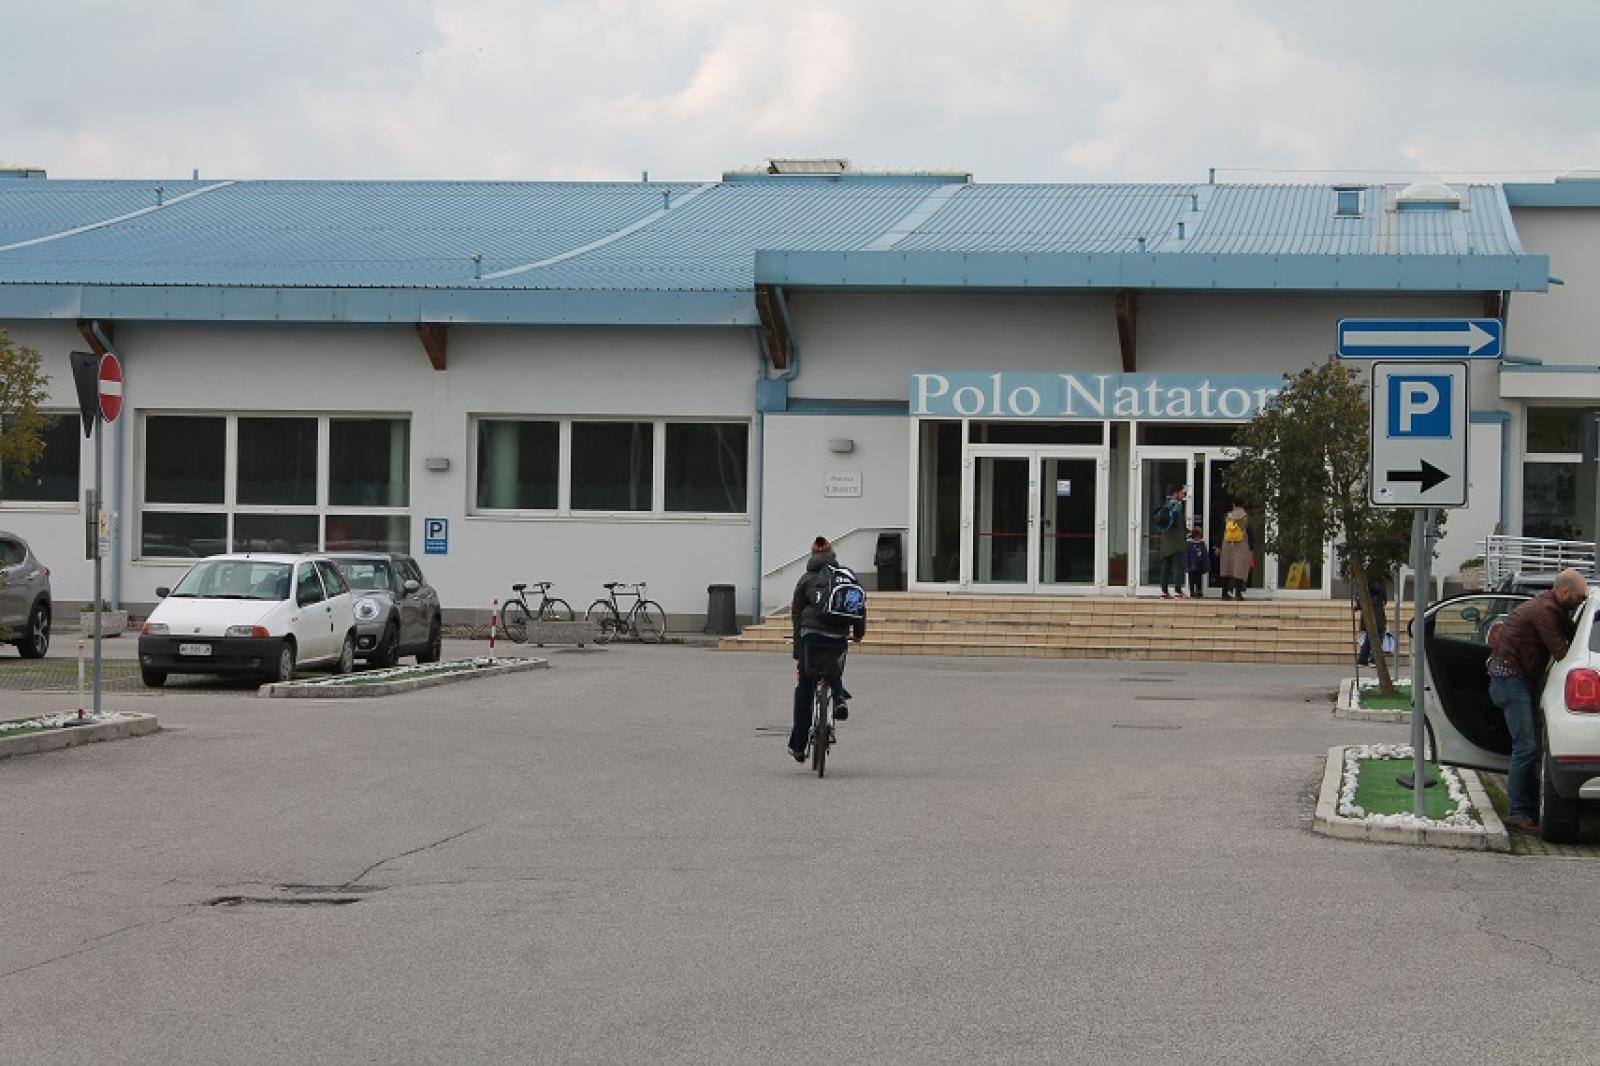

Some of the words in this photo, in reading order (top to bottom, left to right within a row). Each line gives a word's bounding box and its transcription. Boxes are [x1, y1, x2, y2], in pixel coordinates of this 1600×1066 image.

[911, 372, 1041, 416] Polo
[1400, 381, 1440, 432] P
[430, 521, 442, 538] P
